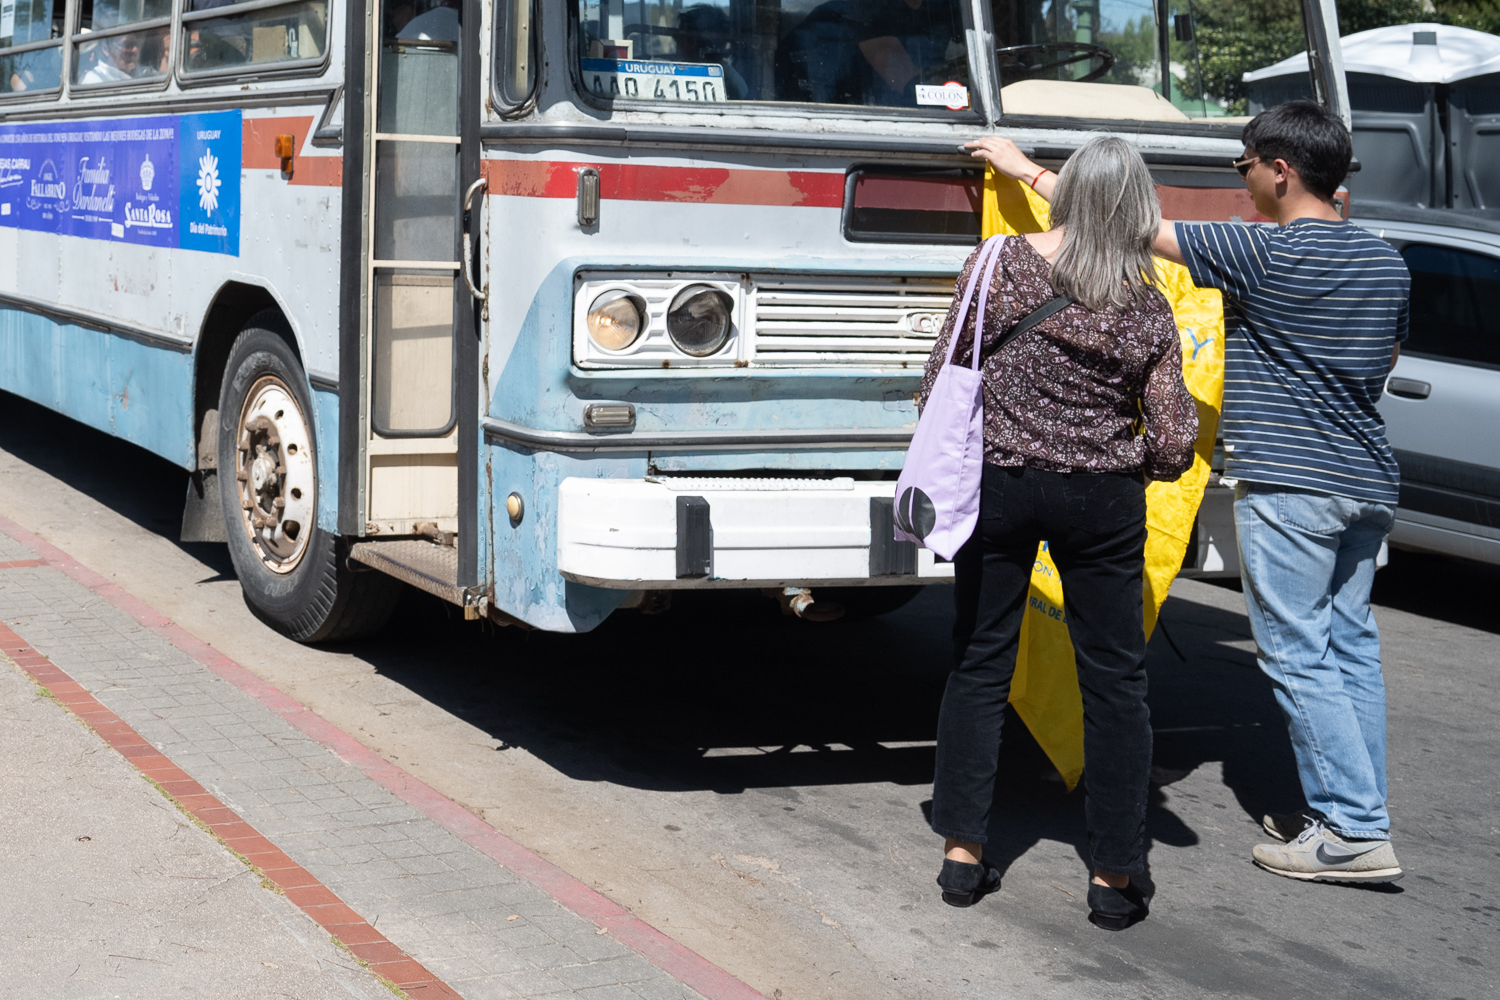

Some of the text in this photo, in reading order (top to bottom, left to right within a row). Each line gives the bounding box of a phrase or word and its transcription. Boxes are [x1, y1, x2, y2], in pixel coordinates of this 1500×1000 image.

[625, 63, 676, 75] URUGUAY
[653, 79, 717, 102] 4150
[197, 129, 221, 140] URUGUAY
[77, 156, 110, 184] Familia
[205, 223, 228, 237] Patrimonio
[1048, 606, 1063, 621] DE
